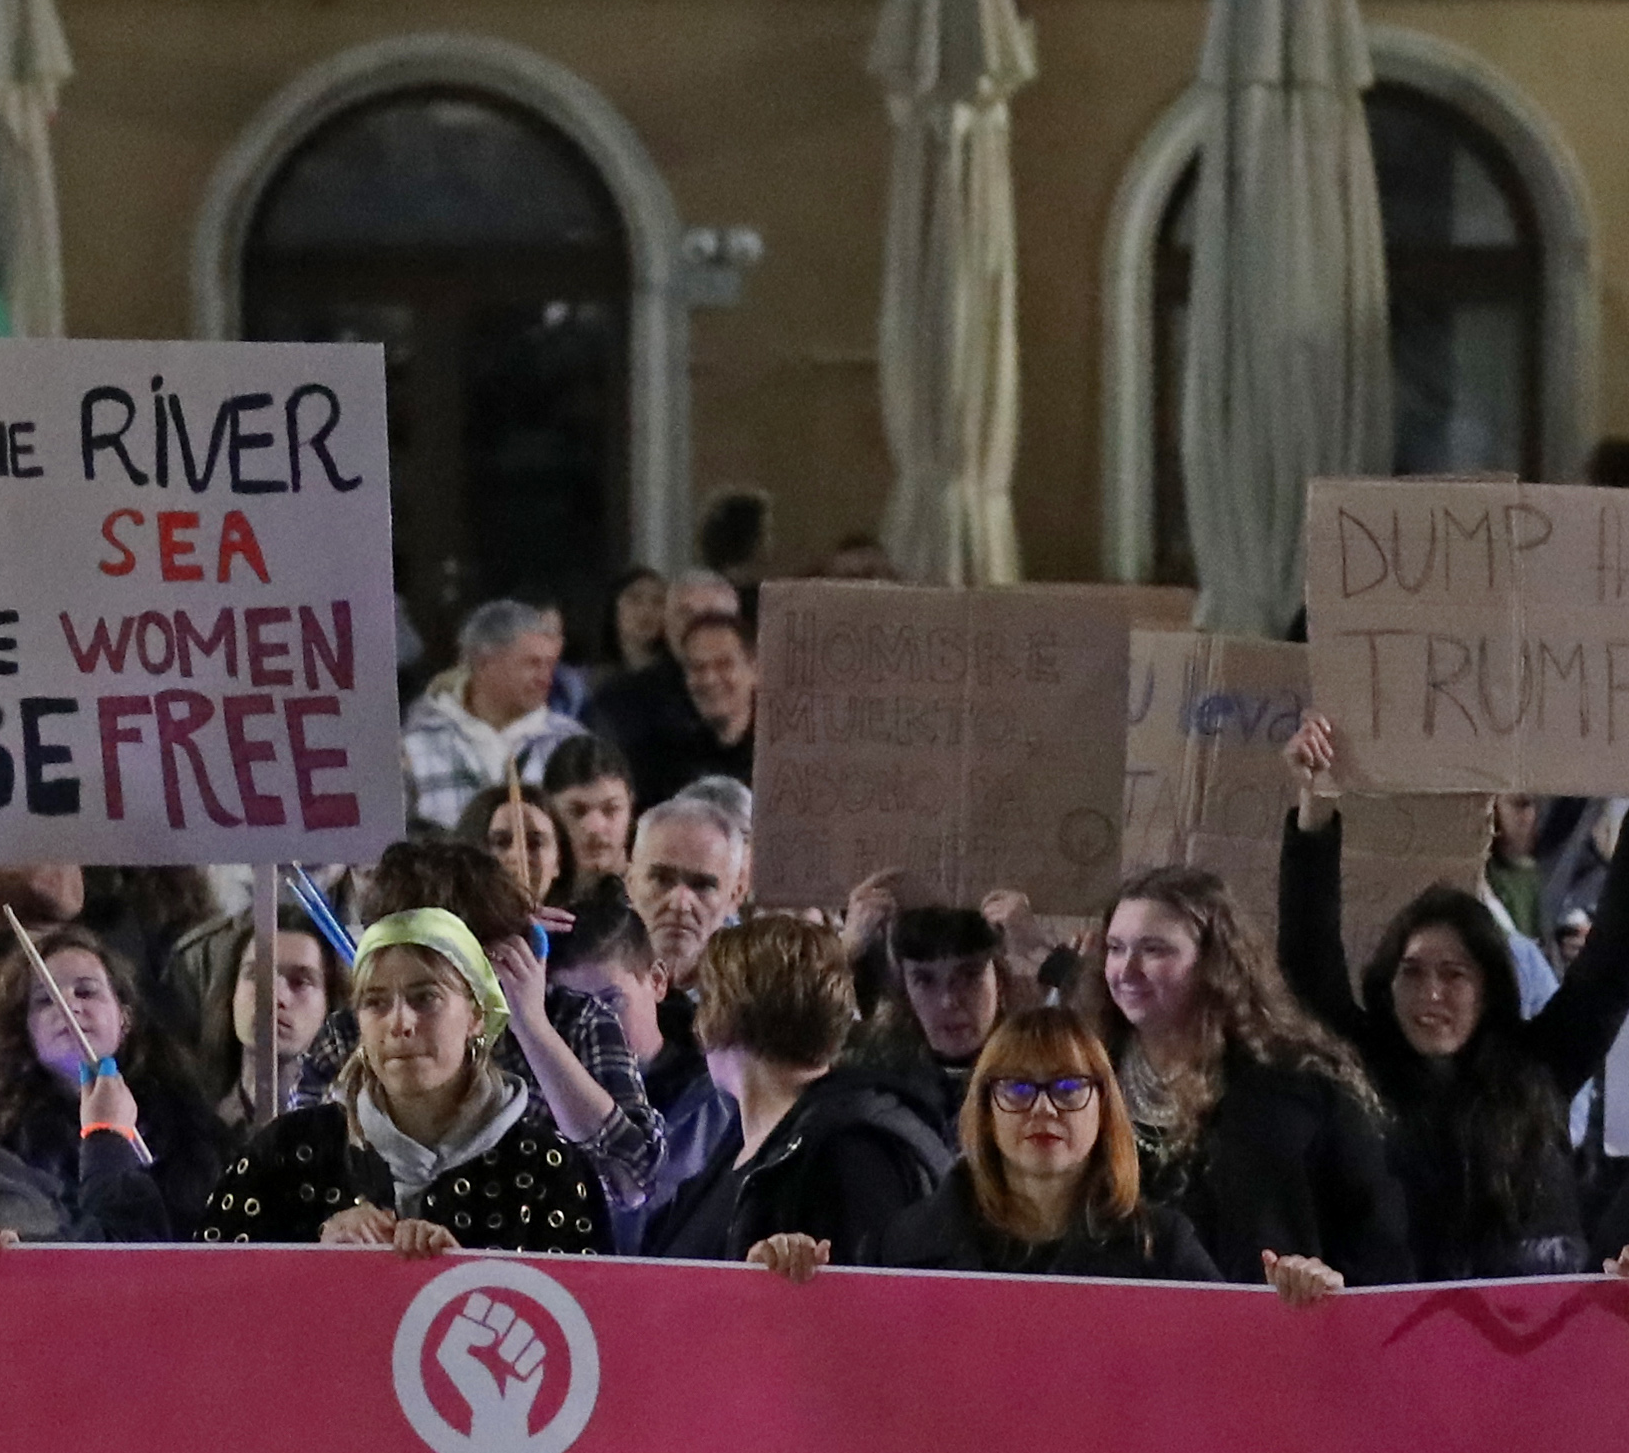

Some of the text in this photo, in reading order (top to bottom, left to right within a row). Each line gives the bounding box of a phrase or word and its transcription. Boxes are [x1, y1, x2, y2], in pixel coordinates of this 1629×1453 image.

[99, 508, 271, 585] SEA
[1339, 502, 1553, 599] DUMP
[59, 600, 355, 691] WOMEN
[97, 688, 361, 831] FREE
